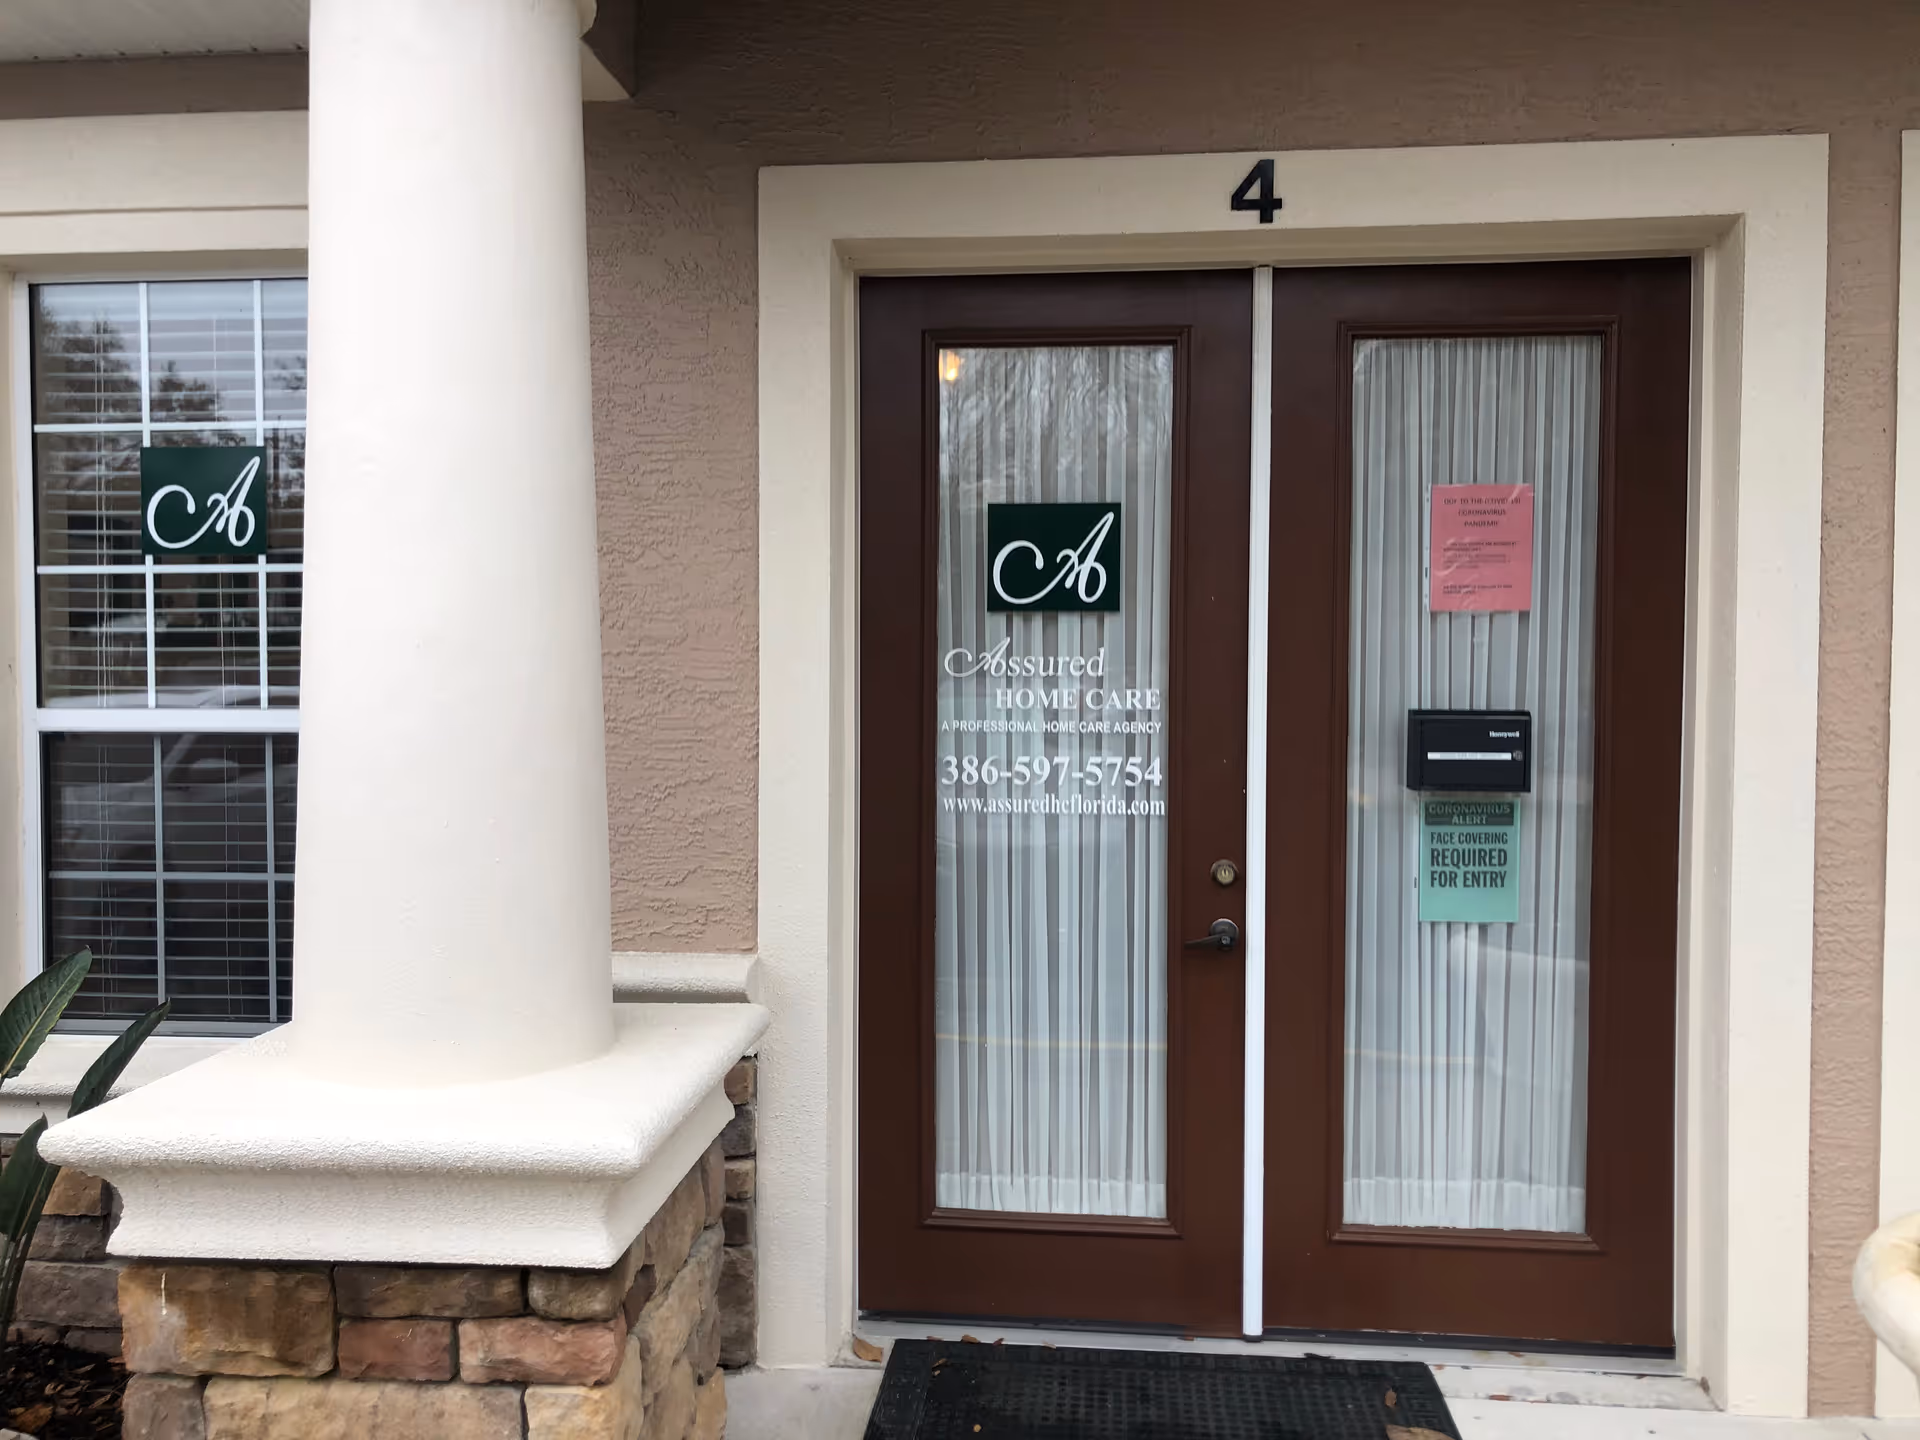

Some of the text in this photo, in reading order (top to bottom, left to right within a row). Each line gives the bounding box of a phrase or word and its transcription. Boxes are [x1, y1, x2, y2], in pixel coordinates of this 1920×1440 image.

[1230, 159, 1283, 224] 4
[944, 636, 1105, 678] Assured
[995, 688, 1161, 710] HOME CARE
[941, 720, 1162, 733] A PROFESSIONAL HOME CARE AGENCY
[941, 755, 1163, 787] 386-597-5754
[943, 793, 1166, 816] www.assuredhcflorida.com
[1428, 803, 1511, 814] CORONAVIRUS
[1451, 815, 1487, 825] ALERT
[1430, 831, 1508, 845] FACE COVERING
[1430, 848, 1508, 869] REQUIRED
[1430, 870, 1507, 888] FOR ENTRY
